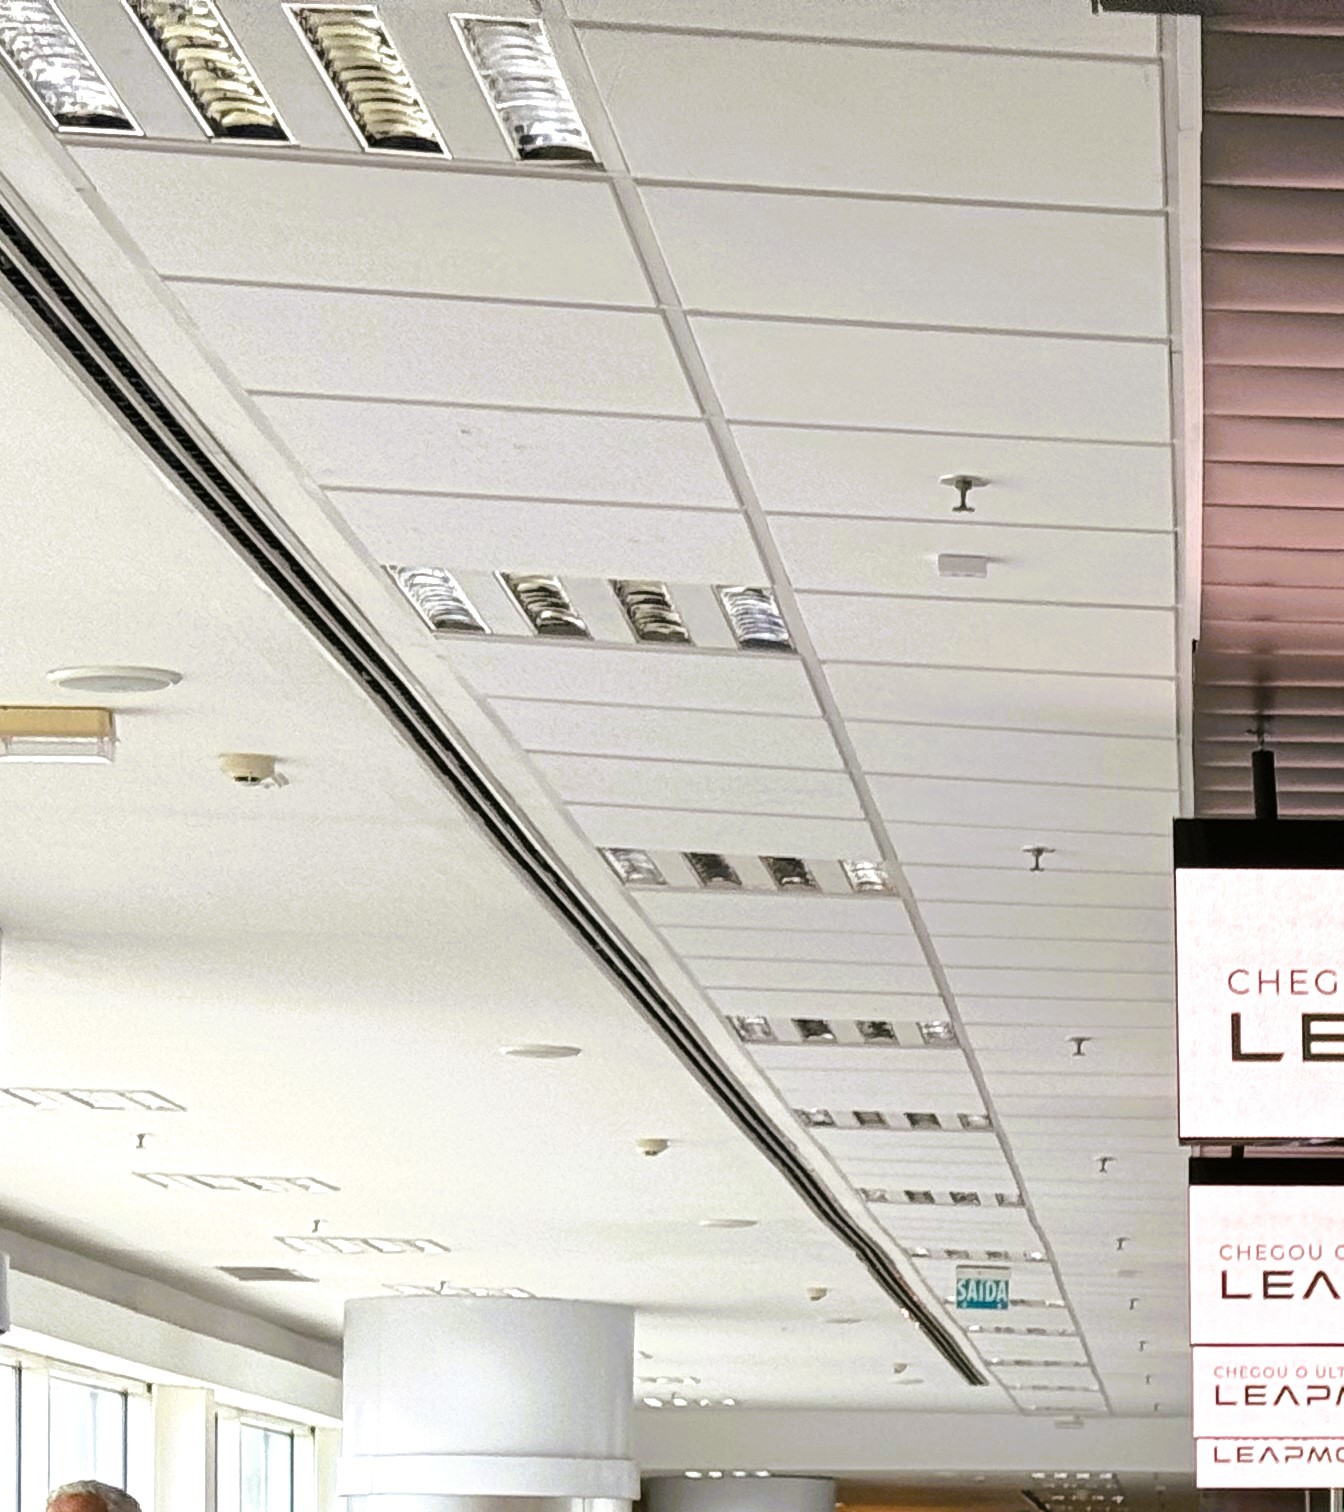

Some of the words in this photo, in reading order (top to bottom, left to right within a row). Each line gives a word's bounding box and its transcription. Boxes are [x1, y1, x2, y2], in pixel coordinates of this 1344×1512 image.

[1219, 1243, 1323, 1261] CHEGOU
[1213, 1365, 1288, 1379] CHEGOU
[1295, 1365, 1308, 1379] O
